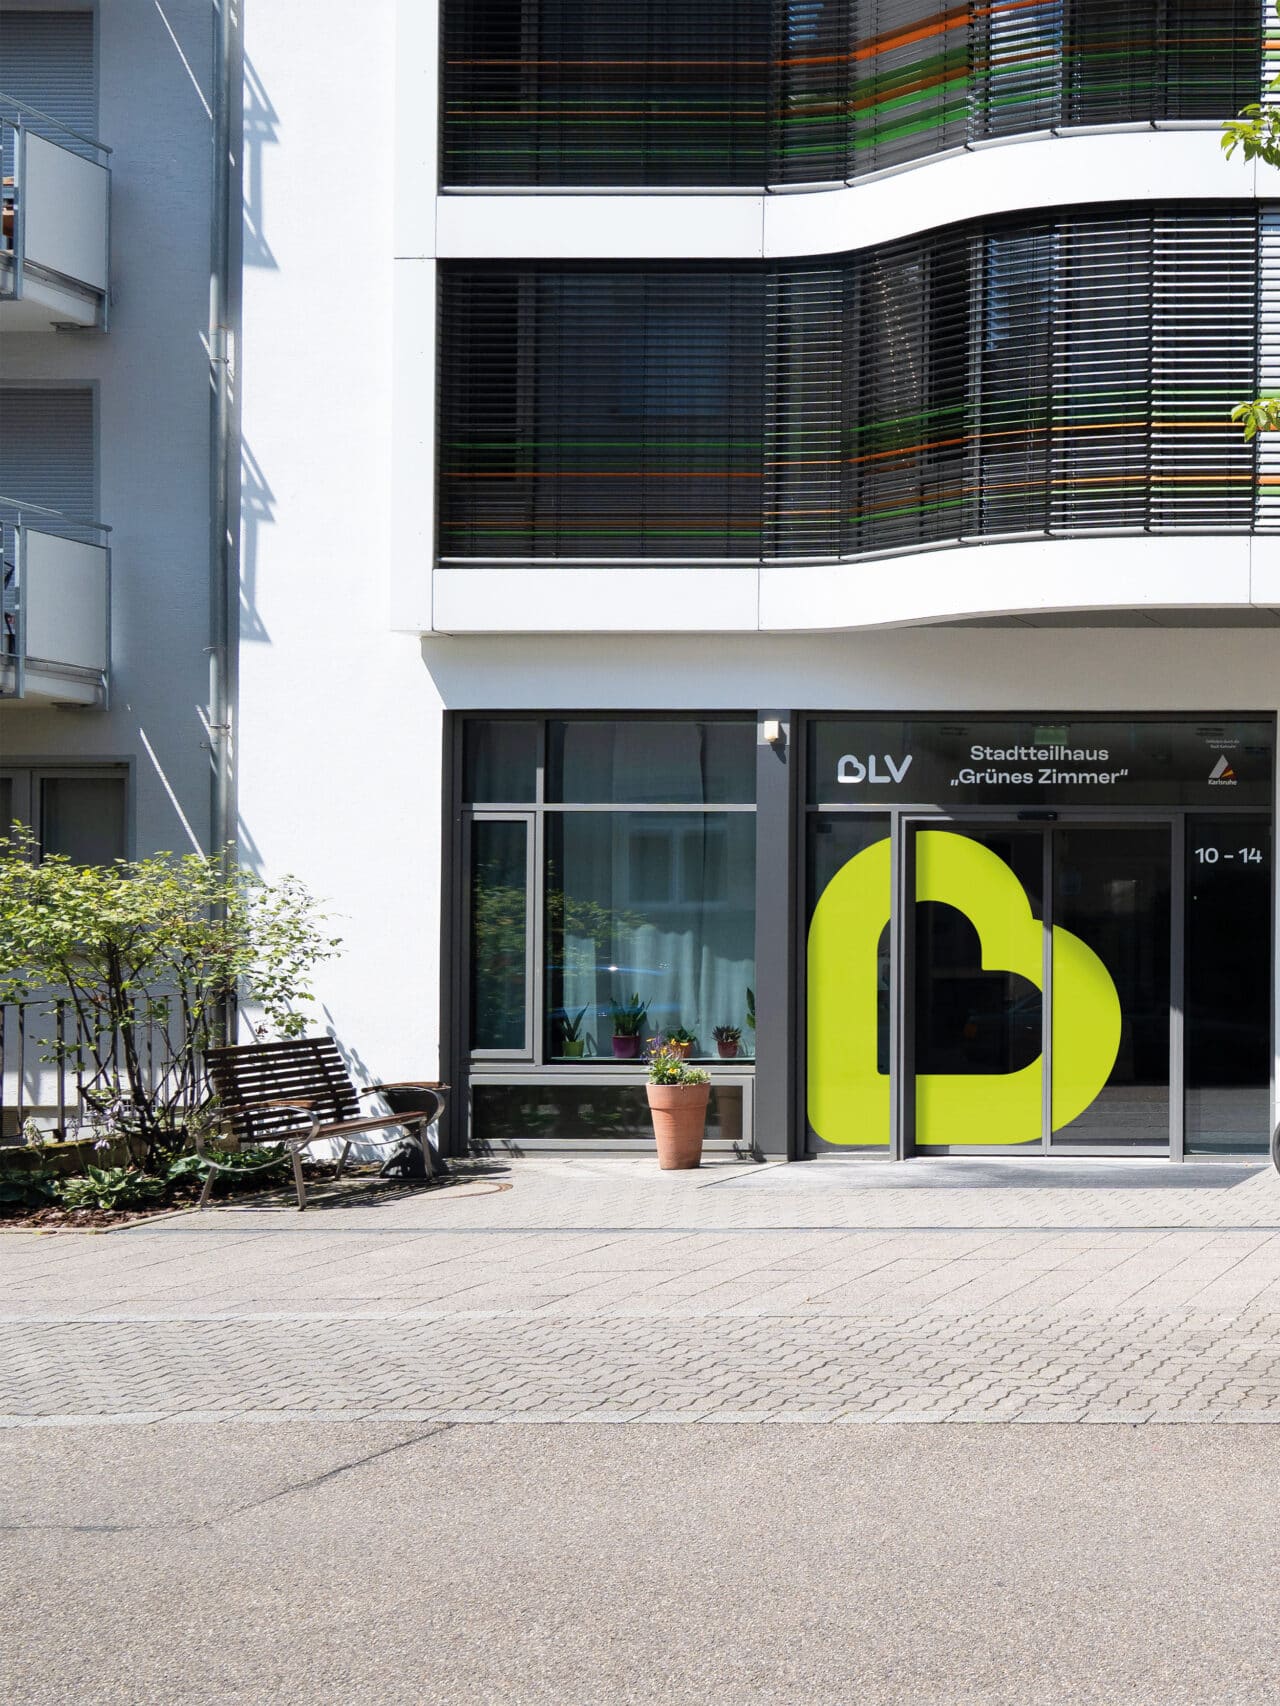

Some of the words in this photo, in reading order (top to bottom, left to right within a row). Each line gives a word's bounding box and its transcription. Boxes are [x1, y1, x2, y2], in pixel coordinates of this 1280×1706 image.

[970, 745, 1109, 761] Stadtteilhaus
[837, 754, 913, 784] BLV
[950, 768, 1034, 787] „Grünes
[1038, 768, 1129, 784] Zimmer“
[1195, 848, 1218, 863] 10
[1238, 848, 1263, 863] 14
